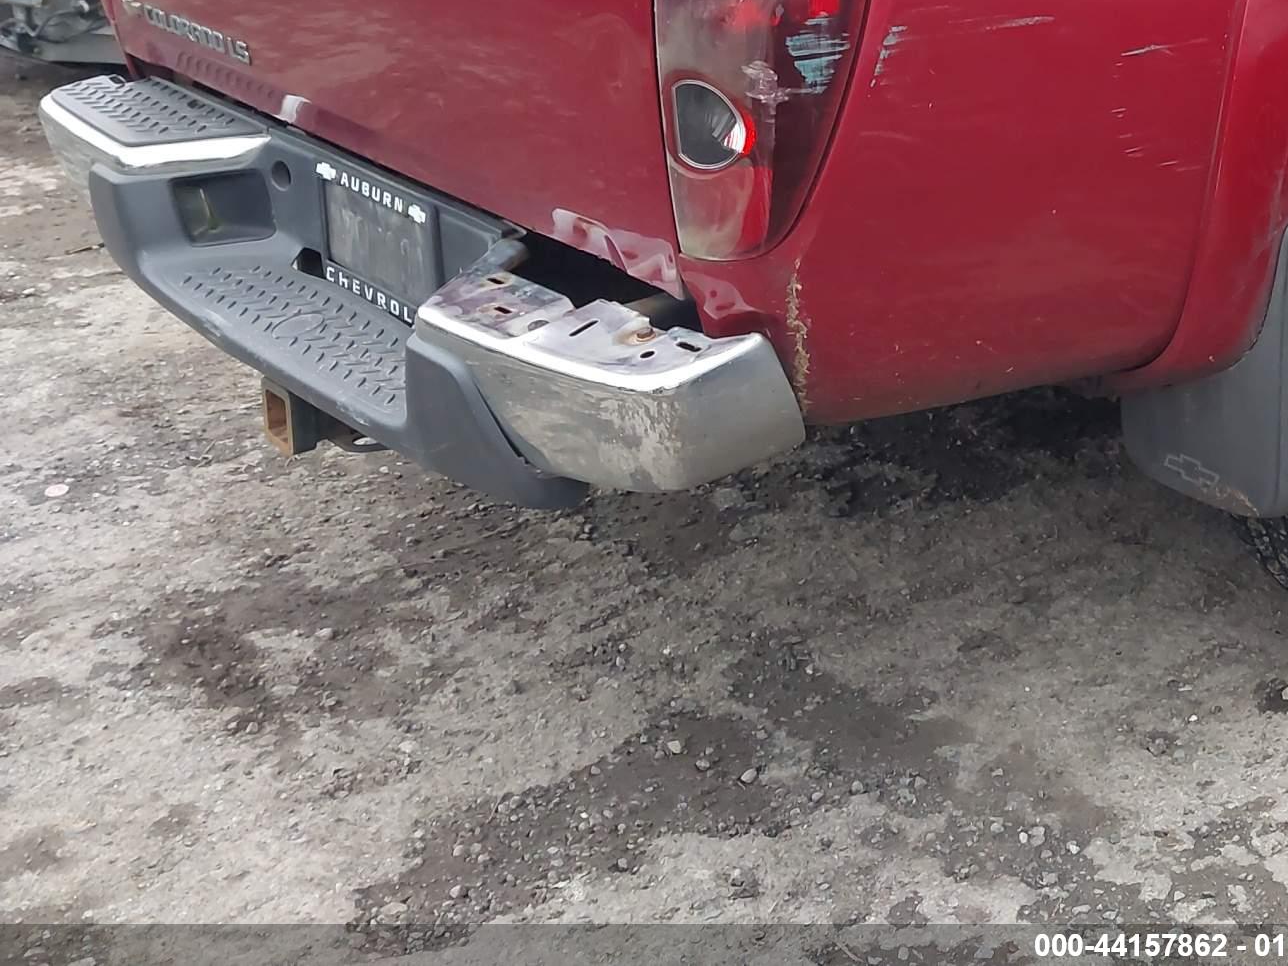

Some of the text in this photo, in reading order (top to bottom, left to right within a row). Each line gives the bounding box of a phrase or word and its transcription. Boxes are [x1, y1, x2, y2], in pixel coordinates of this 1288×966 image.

[143, 4, 252, 66] COLORADO LS
[340, 172, 404, 213] AUBURN
[326, 266, 412, 324] CHEVROL
